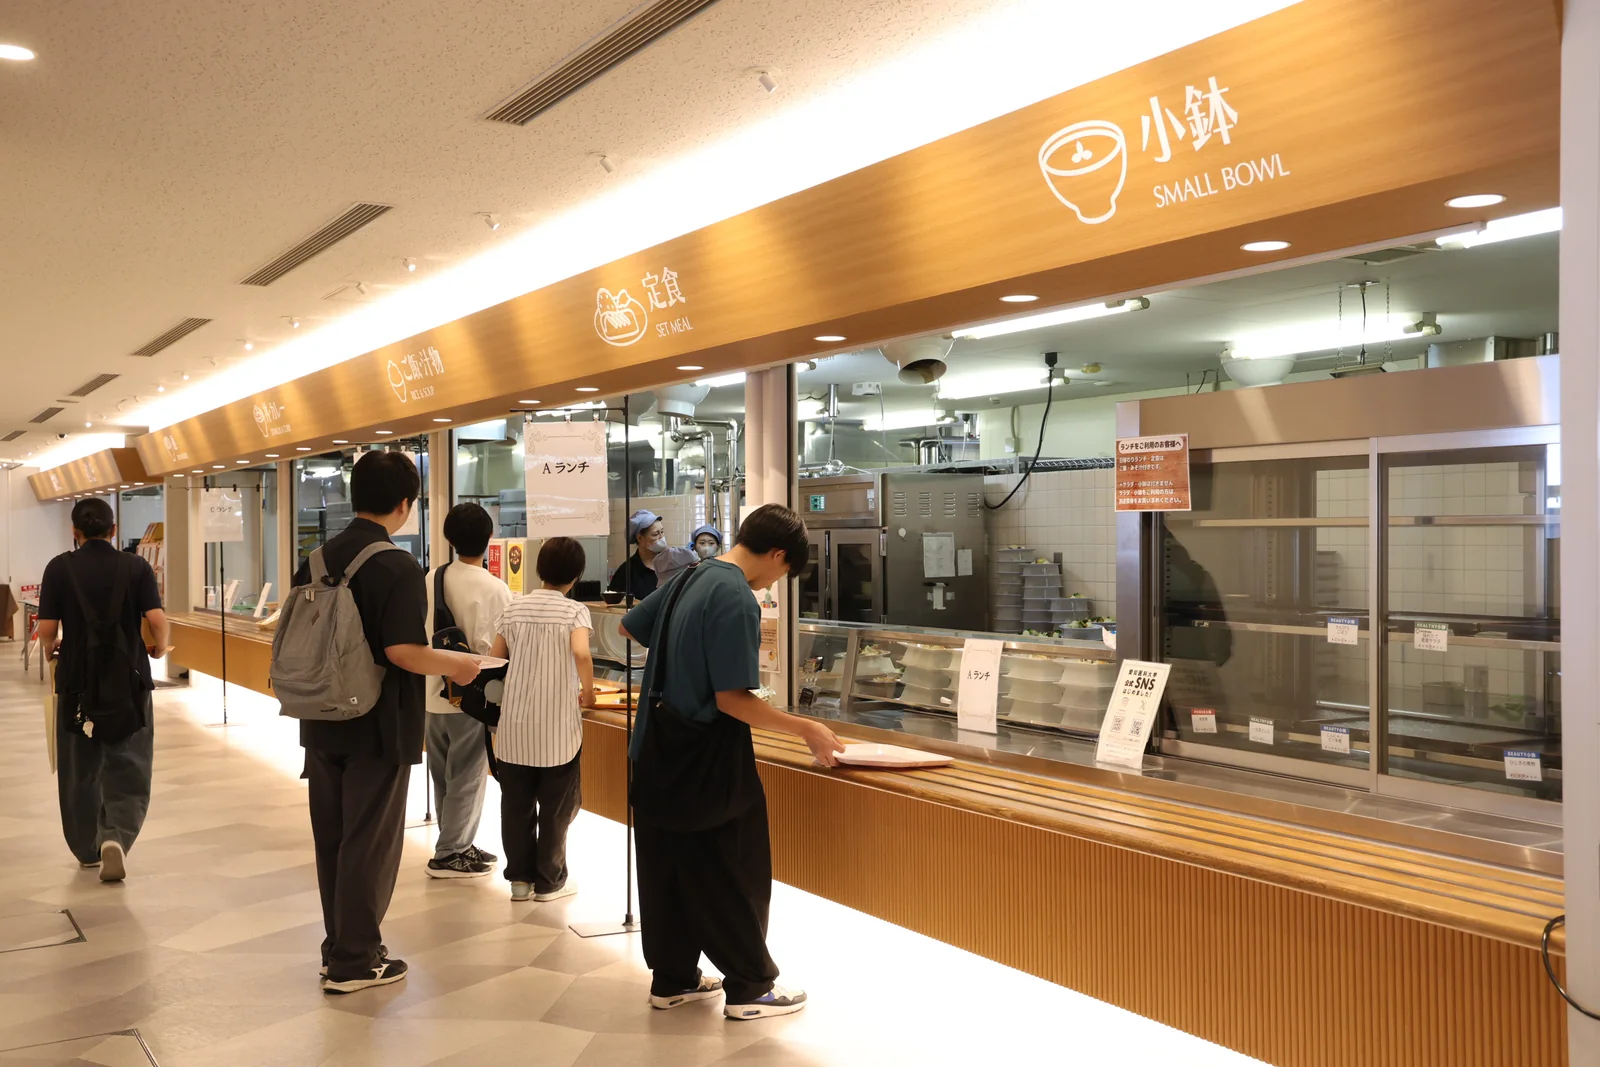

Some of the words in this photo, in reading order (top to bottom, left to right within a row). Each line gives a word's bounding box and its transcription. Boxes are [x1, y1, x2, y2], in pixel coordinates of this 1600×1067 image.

[1141, 76, 1239, 163] 小鉢
[1153, 173, 1218, 208] SMALL
[1221, 153, 1290, 191] BOWL
[641, 266, 686, 313] 定食
[655, 322, 670, 339] SET
[671, 316, 693, 335] MEAL
[1120, 440, 1181, 450] ランチをご利用のお客様へ
[542, 461, 552, 475] A
[555, 461, 590, 475] ランチ
[966, 670, 972, 680] A
[973, 671, 991, 682] ランチ
[1134, 677, 1156, 690] SNS
